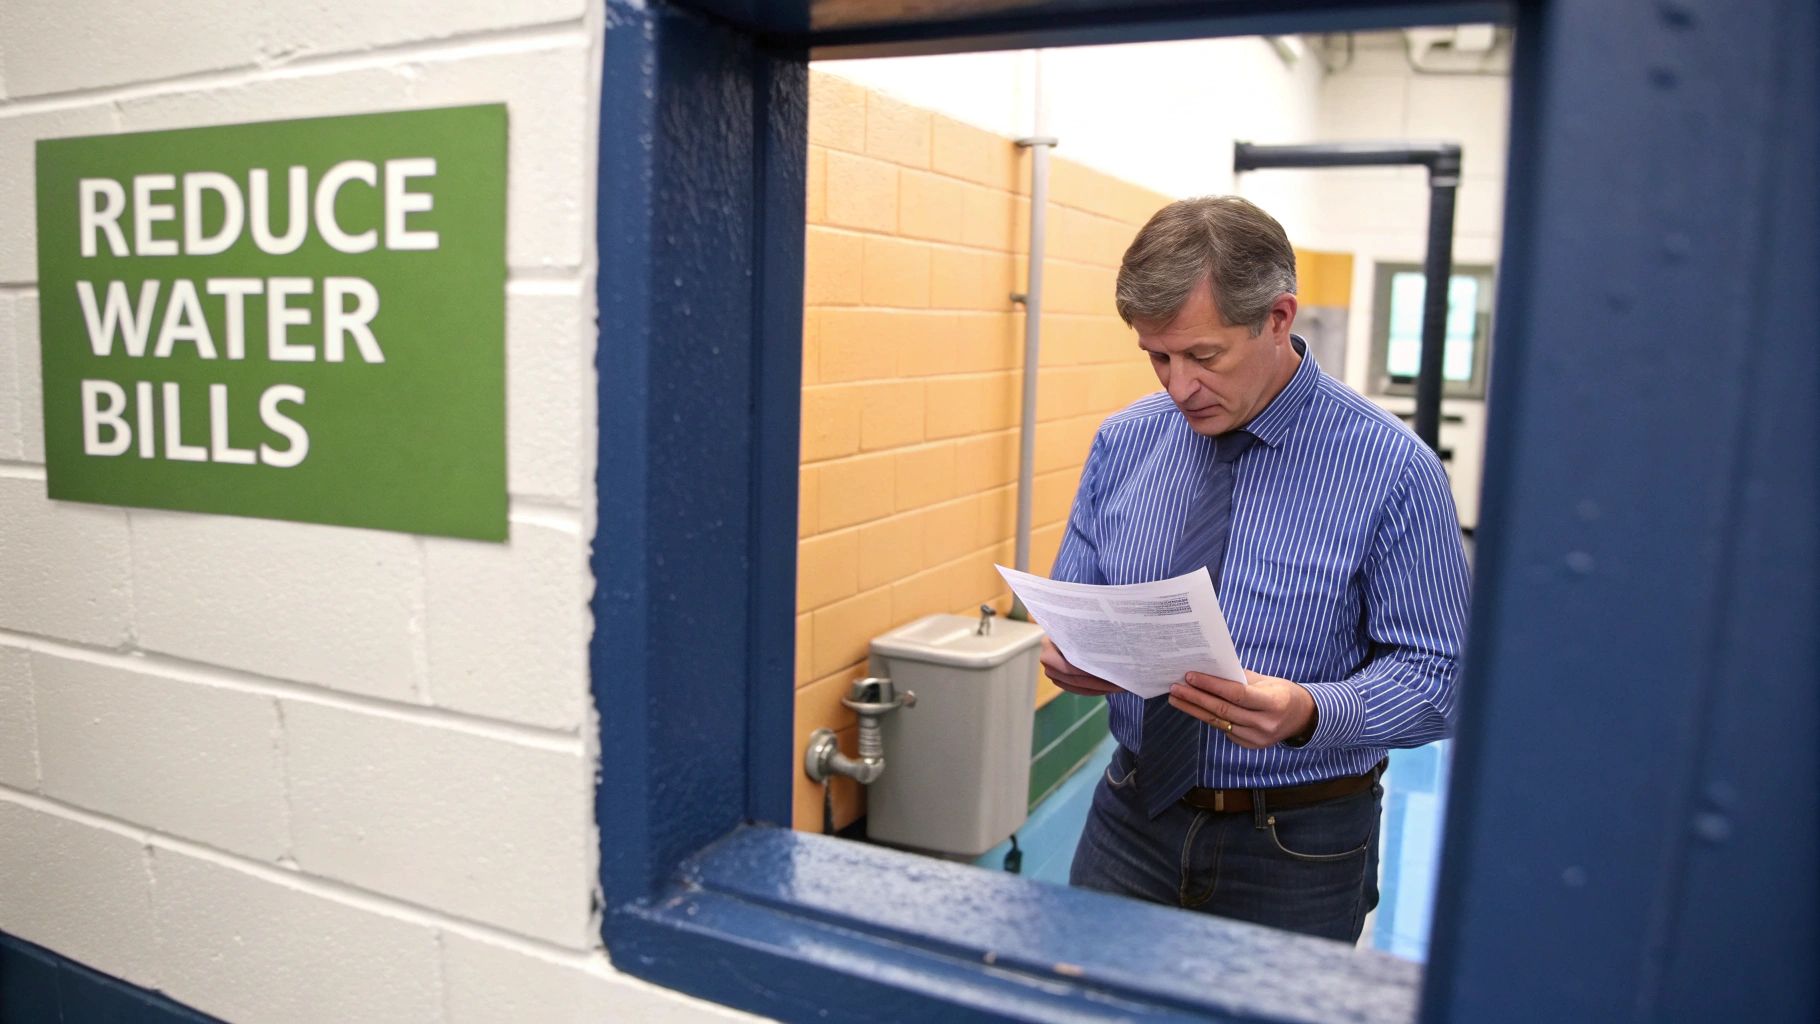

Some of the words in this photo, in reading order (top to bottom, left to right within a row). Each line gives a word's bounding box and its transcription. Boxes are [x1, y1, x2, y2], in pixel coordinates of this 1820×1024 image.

[79, 157, 440, 257] REDUCE
[77, 276, 385, 364] WATER
[82, 380, 310, 468] BILLS
